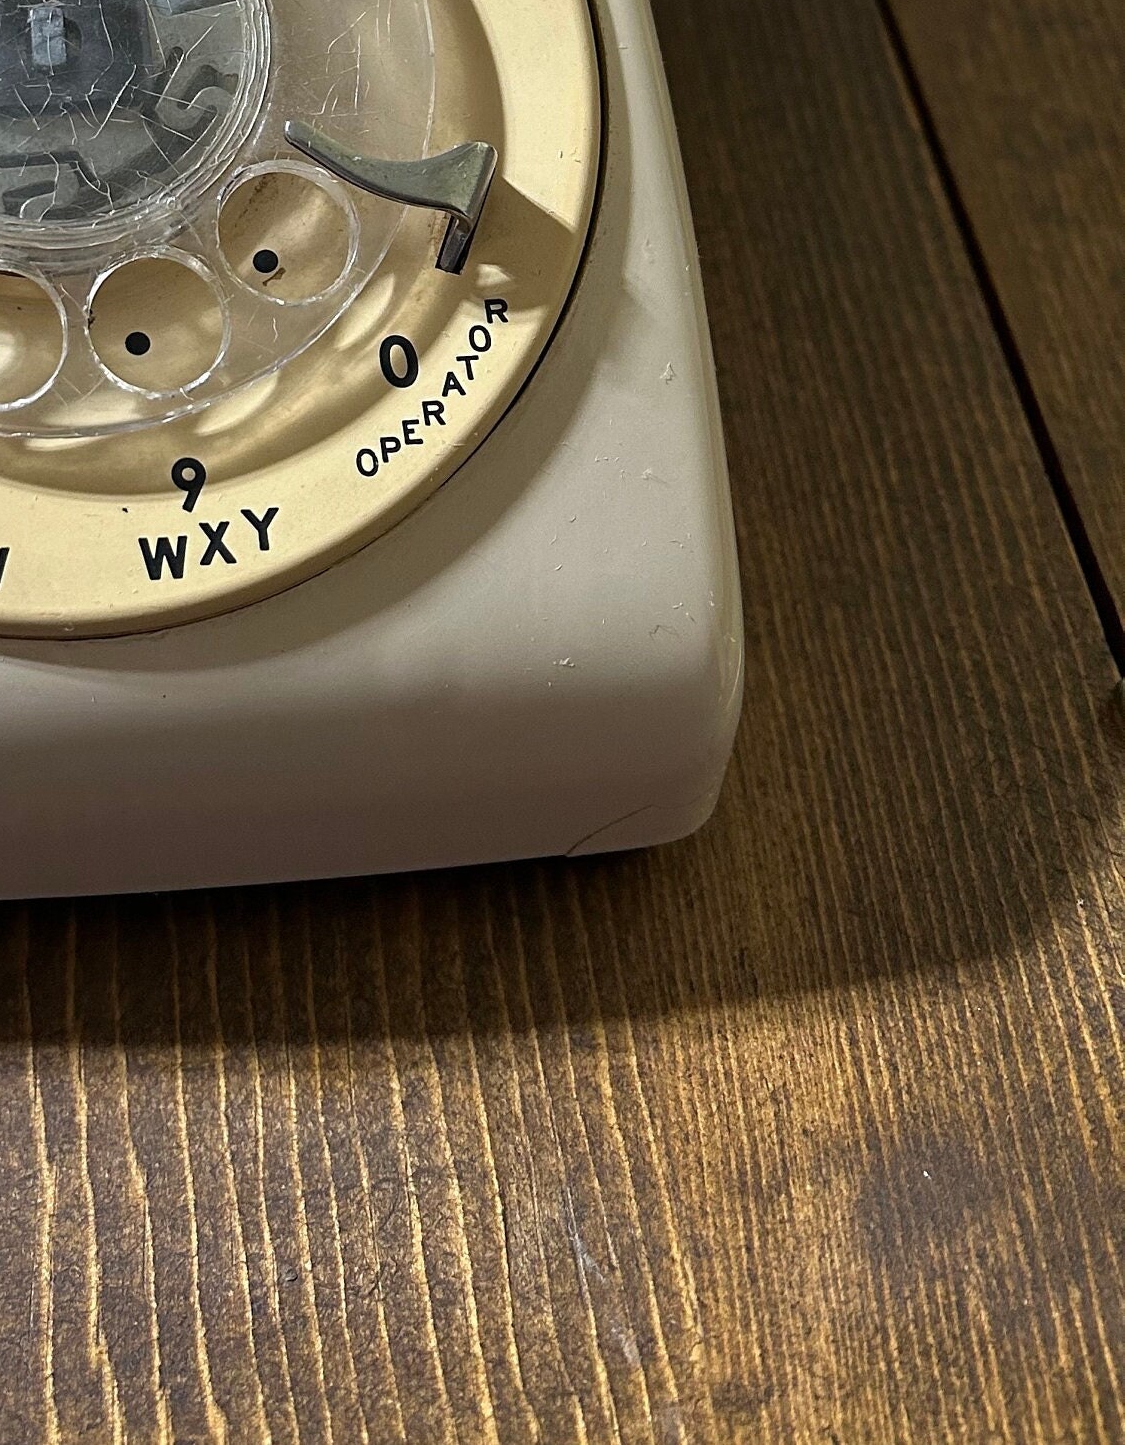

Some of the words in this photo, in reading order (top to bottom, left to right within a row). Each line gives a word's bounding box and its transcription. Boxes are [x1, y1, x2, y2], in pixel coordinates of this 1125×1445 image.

[356, 298, 509, 477] OPERATOR
[379, 334, 419, 389] 0
[171, 457, 207, 513] 9
[138, 507, 280, 581] WXY
